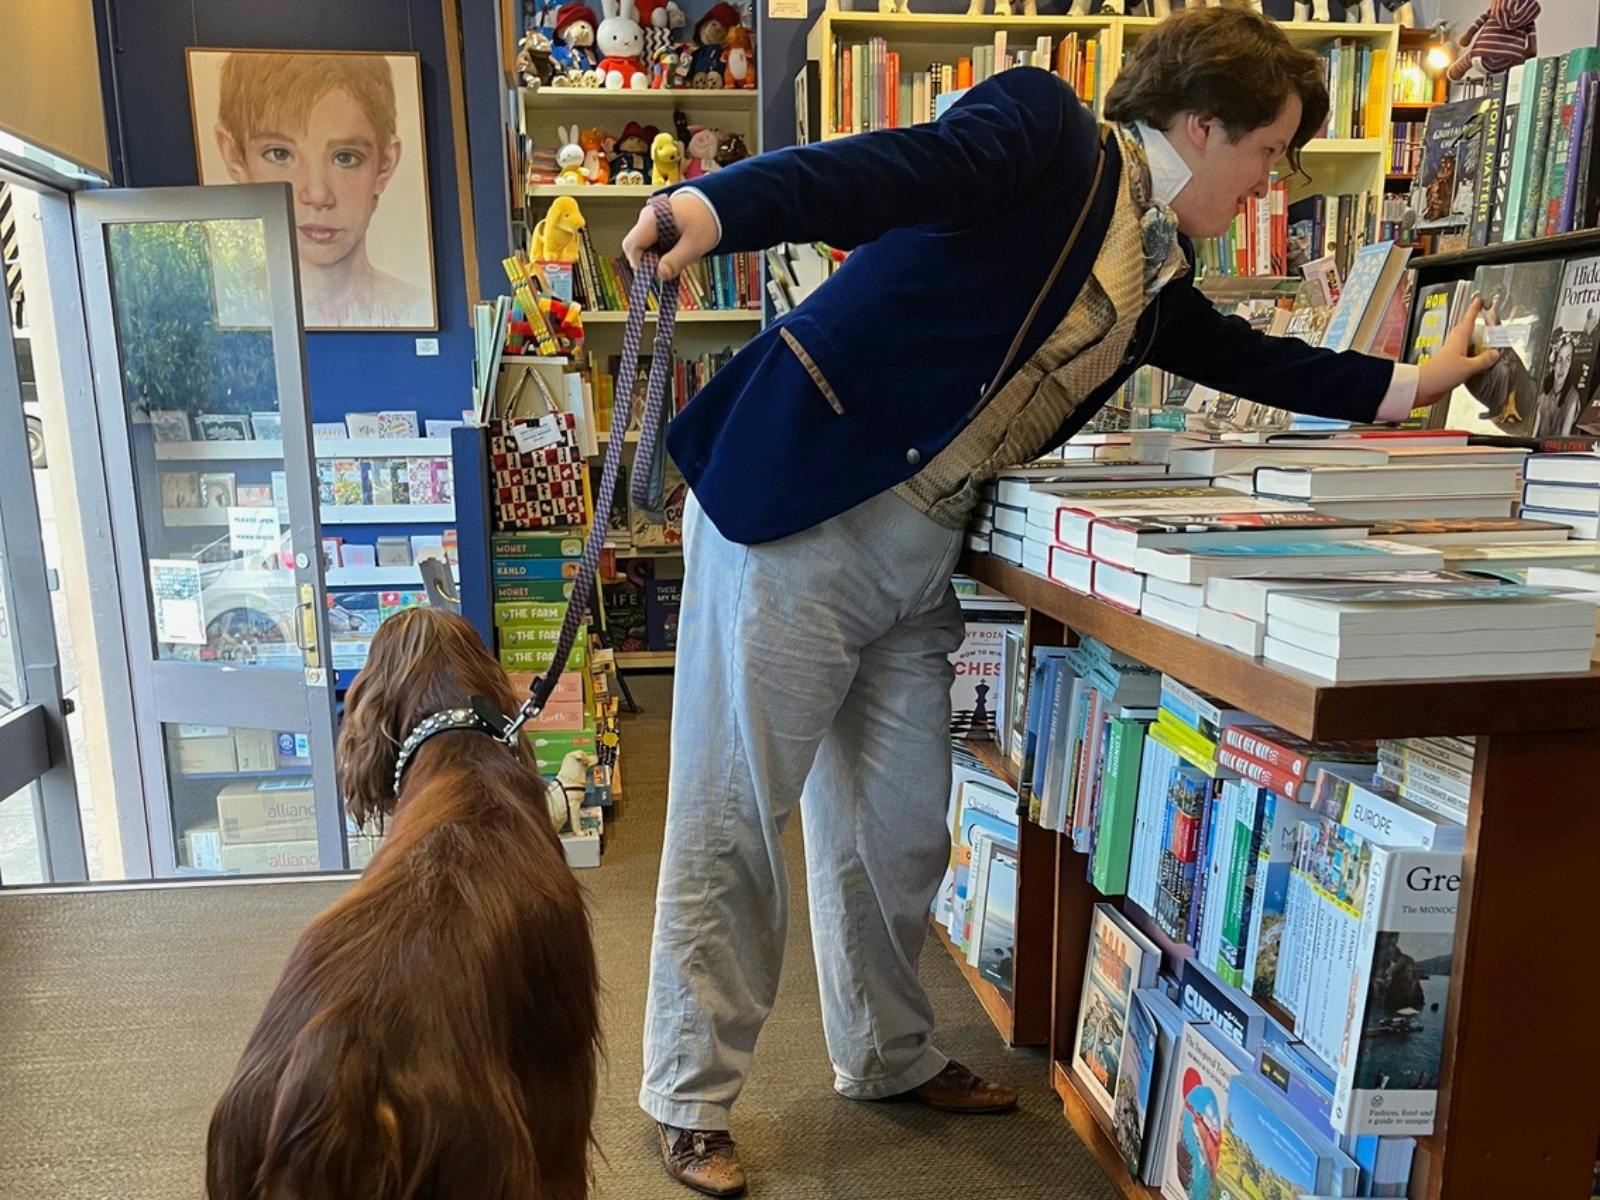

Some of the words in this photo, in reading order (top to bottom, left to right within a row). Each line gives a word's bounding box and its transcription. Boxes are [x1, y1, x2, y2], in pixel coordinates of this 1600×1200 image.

[1487, 98, 1500, 147] HOME
[1492, 114, 1515, 222] VIENNA
[1478, 151, 1494, 222] MATTERS
[496, 544, 527, 553] MONET
[497, 567, 526, 576] KAHLO
[498, 588, 529, 596] MONET
[509, 609, 528, 618] THE
[532, 608, 558, 618] FARM
[516, 630, 535, 640] THE
[514, 653, 532, 662] THE
[960, 650, 976, 659] HOW
[1112, 734, 1121, 778] LONDON
[1353, 804, 1393, 836] EUROPE
[1406, 866, 1462, 892] Gre
[1366, 861, 1381, 922] Greece
[1402, 905, 1417, 914] The
[1420, 905, 1457, 914] MONOC
[1338, 918, 1347, 961] AUSTRIA
[1184, 984, 1244, 1048] CURVES
[1369, 1109, 1399, 1117] Fashion,
[1401, 1108, 1418, 1116] food
[1420, 1108, 1434, 1116] and
[1373, 1117, 1394, 1126] guide
[1404, 1117, 1430, 1126] unique
